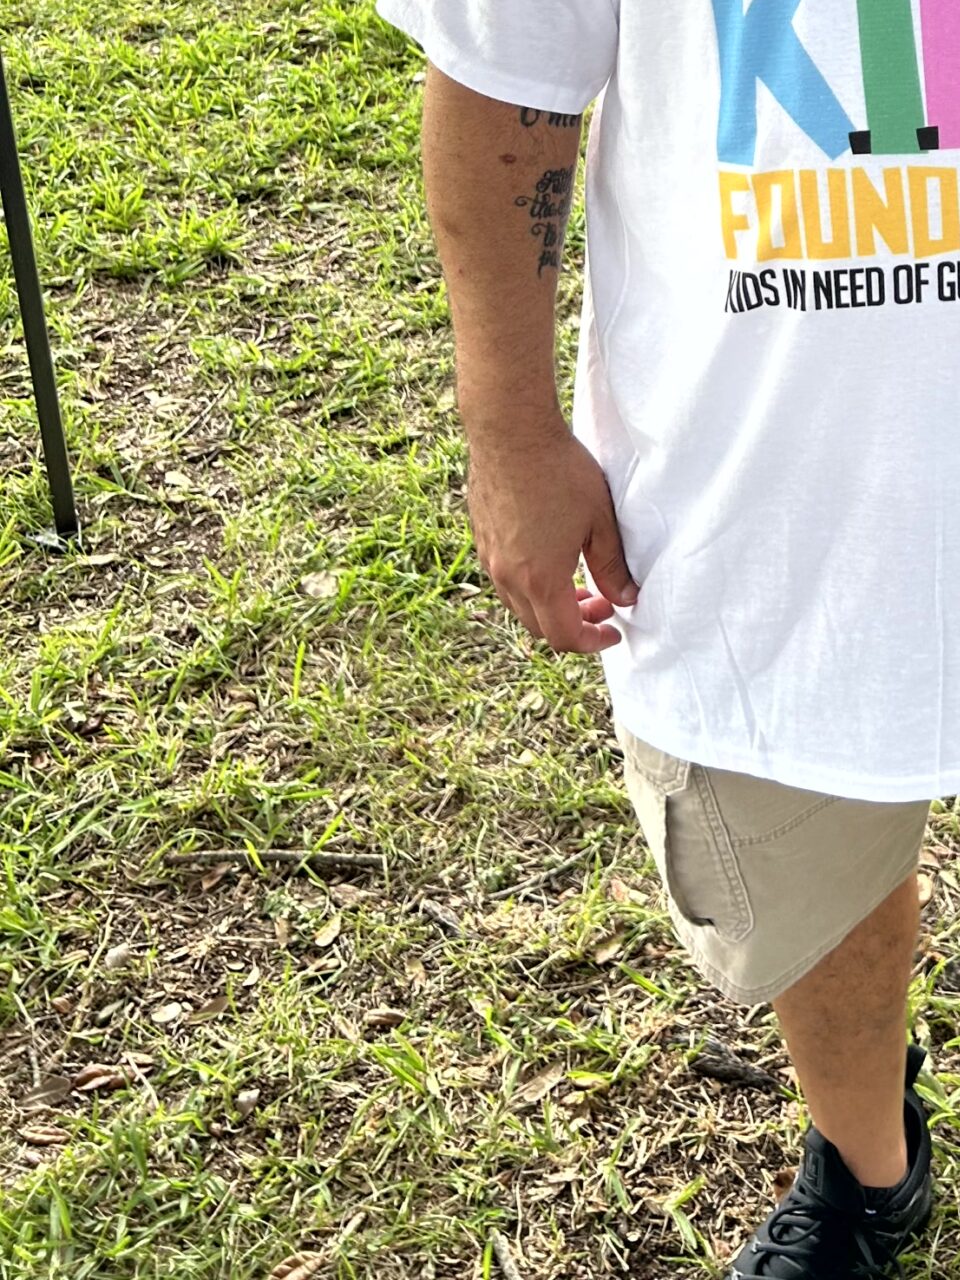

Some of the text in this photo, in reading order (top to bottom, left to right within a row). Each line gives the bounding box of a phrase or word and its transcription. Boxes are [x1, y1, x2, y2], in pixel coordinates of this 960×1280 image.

[725, 269, 780, 314] KIDS
[782, 268, 806, 312] IN
[813, 267, 885, 311] NEED
[893, 262, 930, 305] OF
